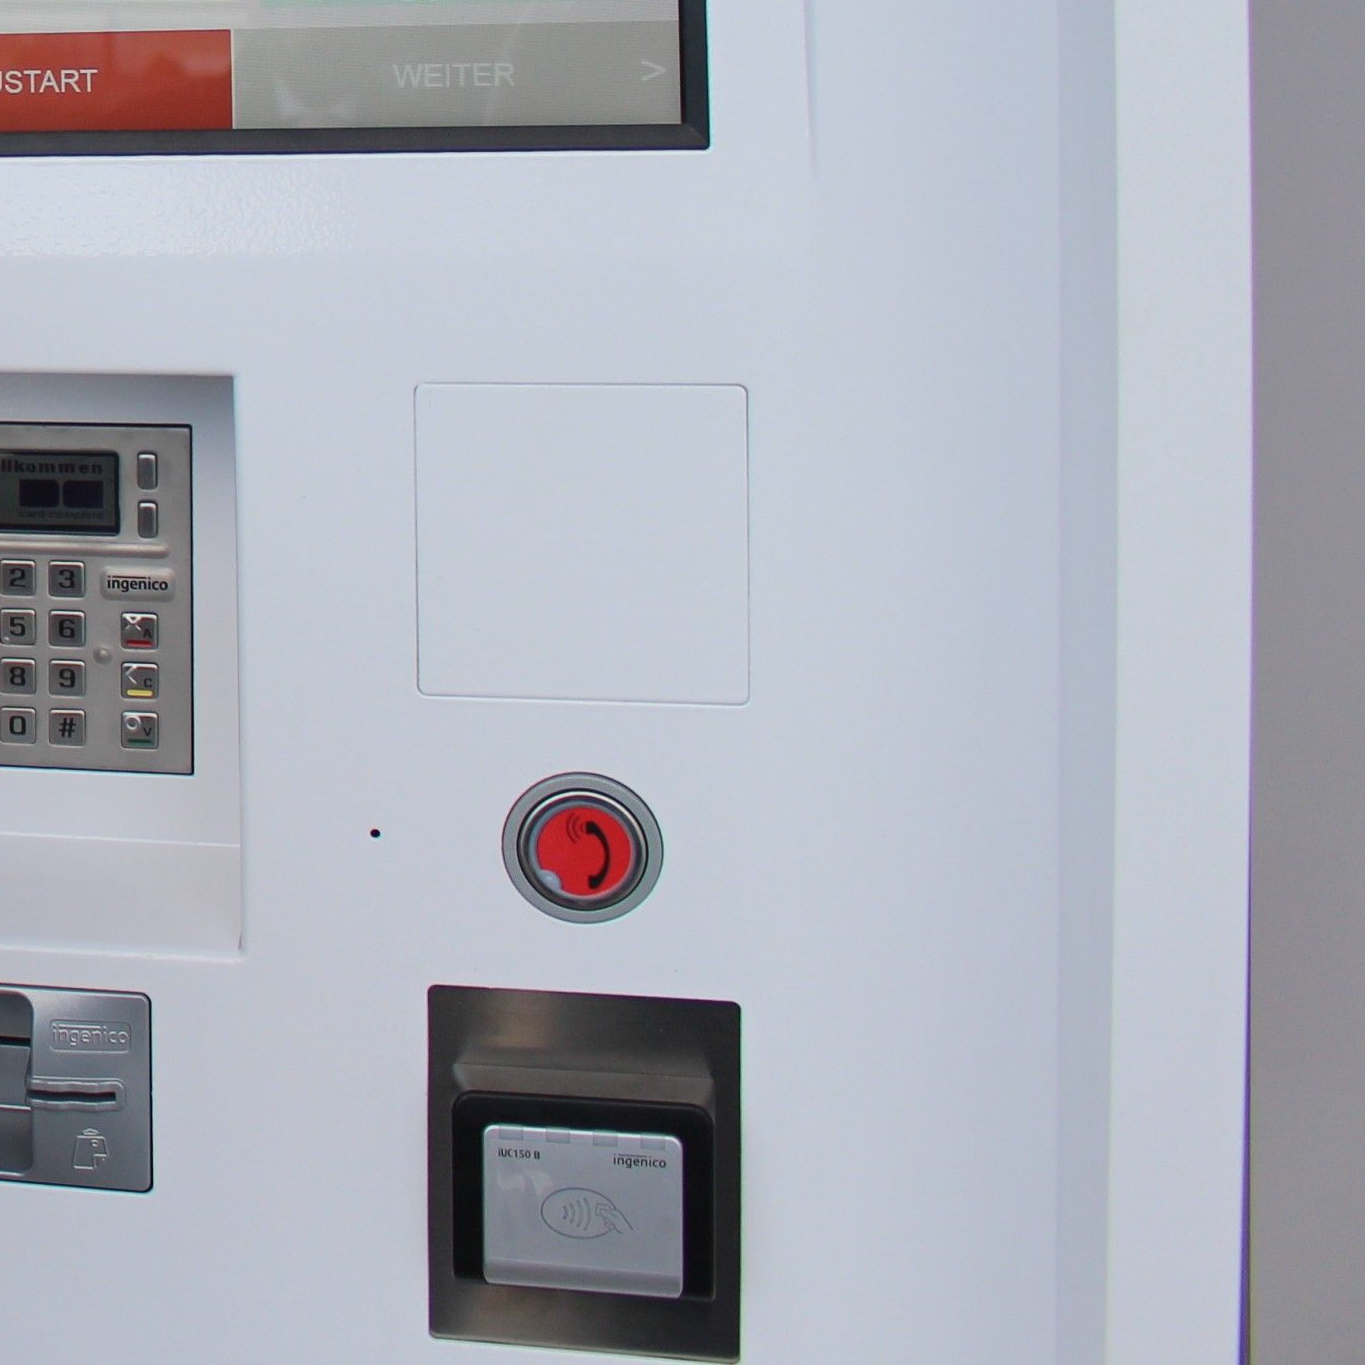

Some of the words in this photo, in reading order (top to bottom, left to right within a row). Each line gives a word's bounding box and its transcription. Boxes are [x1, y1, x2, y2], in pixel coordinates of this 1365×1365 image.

[392, 62, 516, 89] WEITER
[8, 567, 26, 588] 2
[58, 569, 76, 589] 3
[107, 574, 169, 592] ingenico
[9, 616, 26, 637] 5
[58, 618, 76, 639] 6
[9, 666, 26, 686] 8
[58, 668, 76, 688] 9
[8, 715, 27, 736] 0
[52, 1023, 129, 1046] ingenico
[613, 1153, 667, 1169] ingenico
